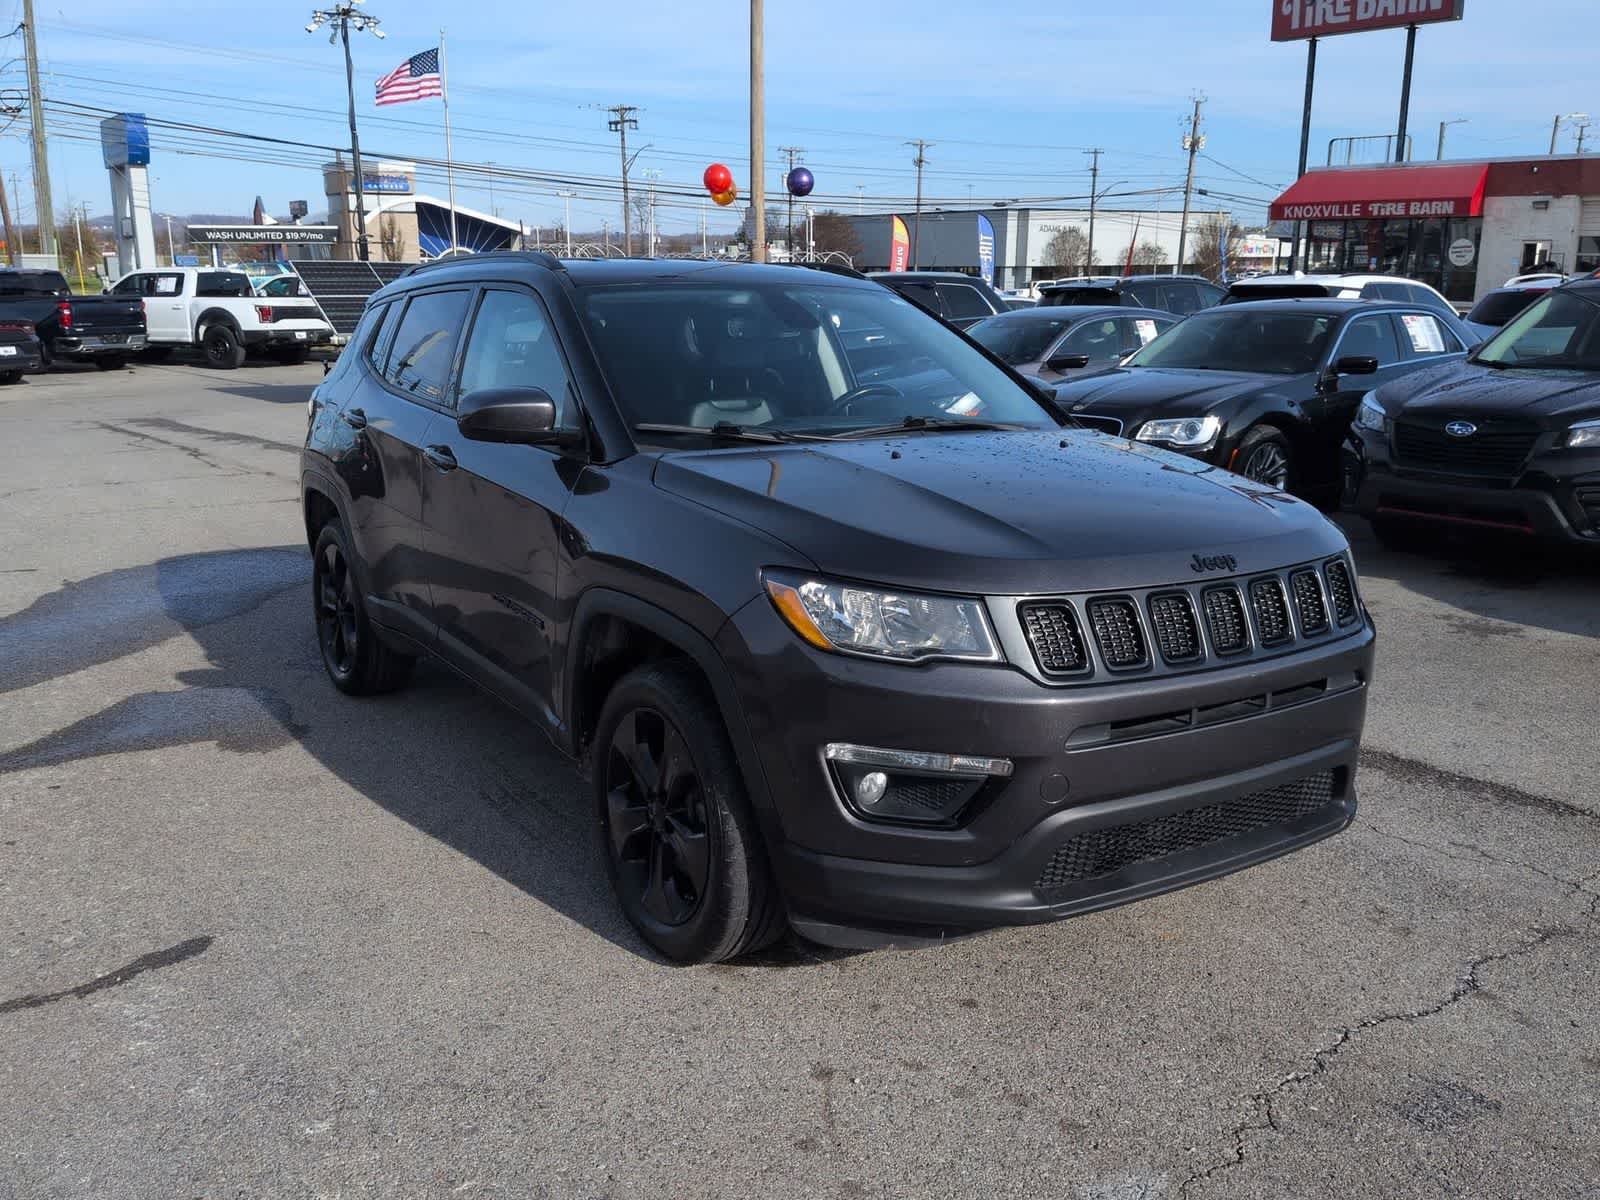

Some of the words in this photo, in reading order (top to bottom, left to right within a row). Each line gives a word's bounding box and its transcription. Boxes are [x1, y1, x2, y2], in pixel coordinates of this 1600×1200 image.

[1284, 204, 1361, 218] KNOXVILLE
[1409, 201, 1455, 215] BARN
[206, 231, 234, 240] WASH
[235, 231, 283, 240] UNLIMITED
[1190, 554, 1237, 573] Jeep
